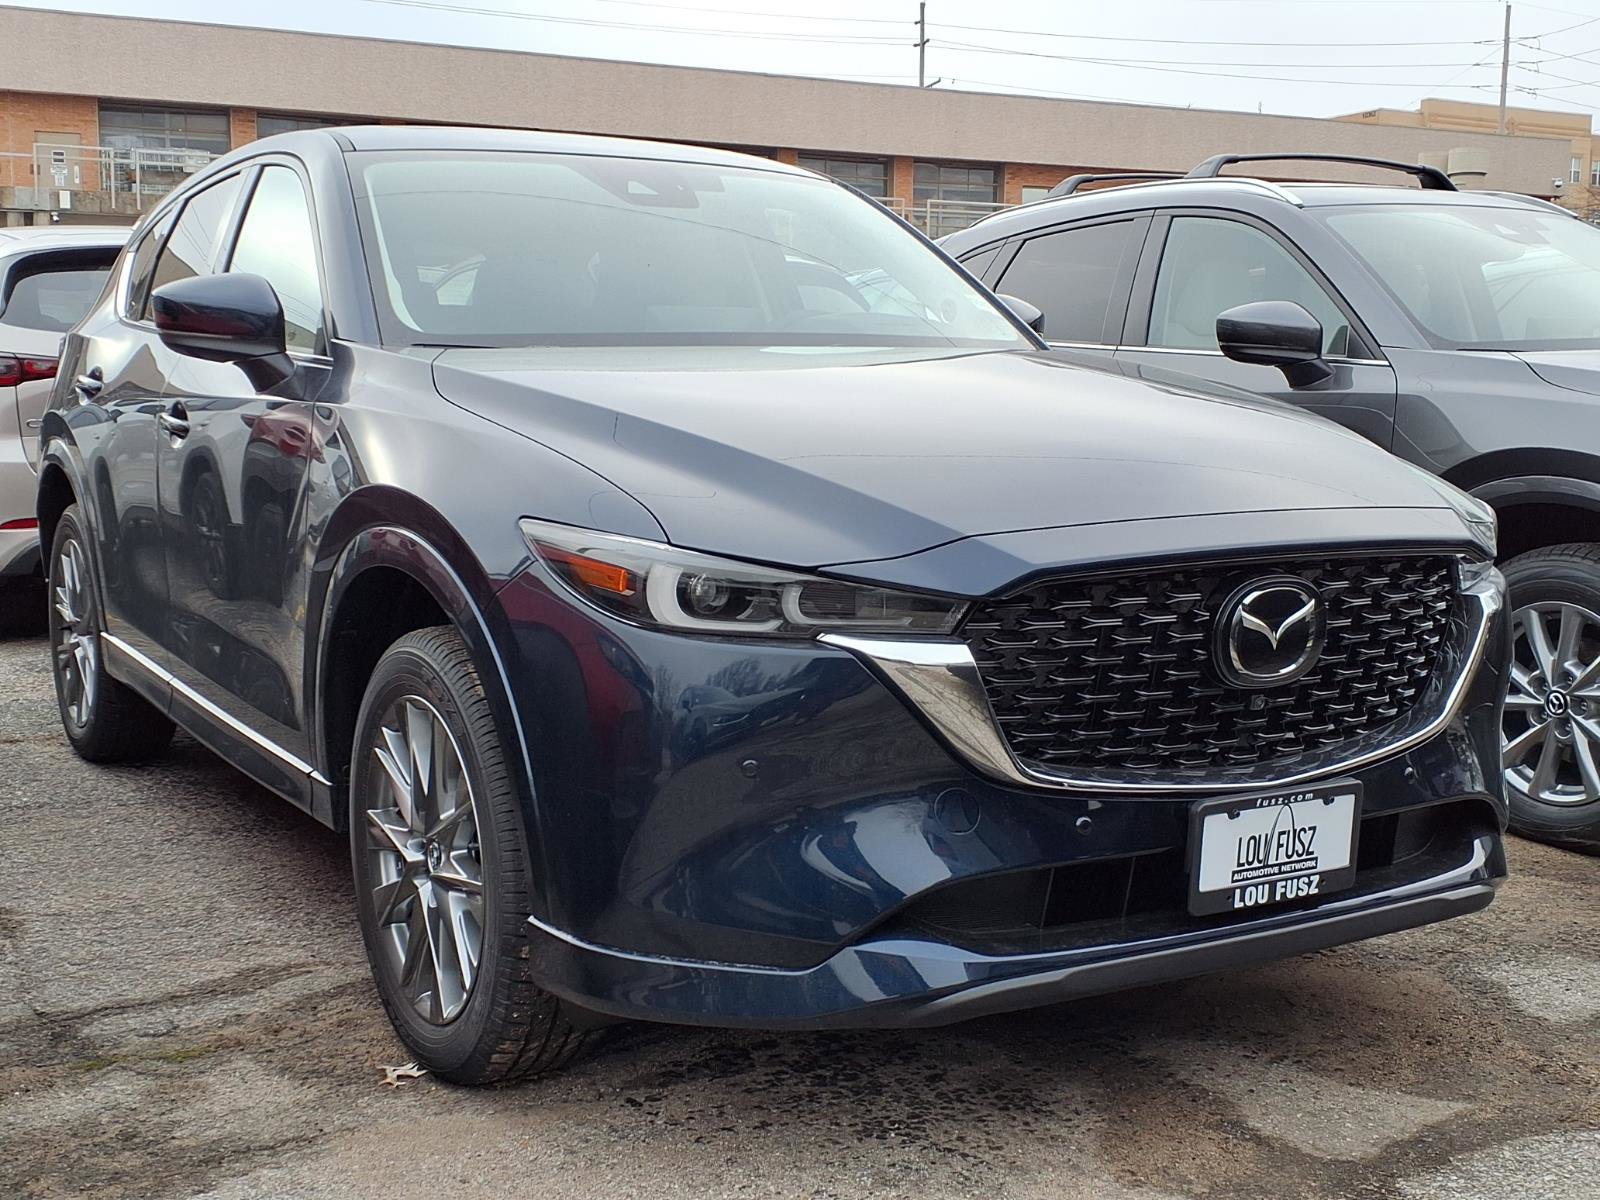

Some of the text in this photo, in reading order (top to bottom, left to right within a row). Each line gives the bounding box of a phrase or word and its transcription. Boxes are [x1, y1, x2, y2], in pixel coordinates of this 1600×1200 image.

[1256, 792, 1314, 807] fusz.com
[1237, 826, 1317, 868] LOU FUSZ
[1233, 859, 1317, 881] AUTOMOTIVE NETWORK
[1233, 875, 1320, 908] LOU FUSZ
